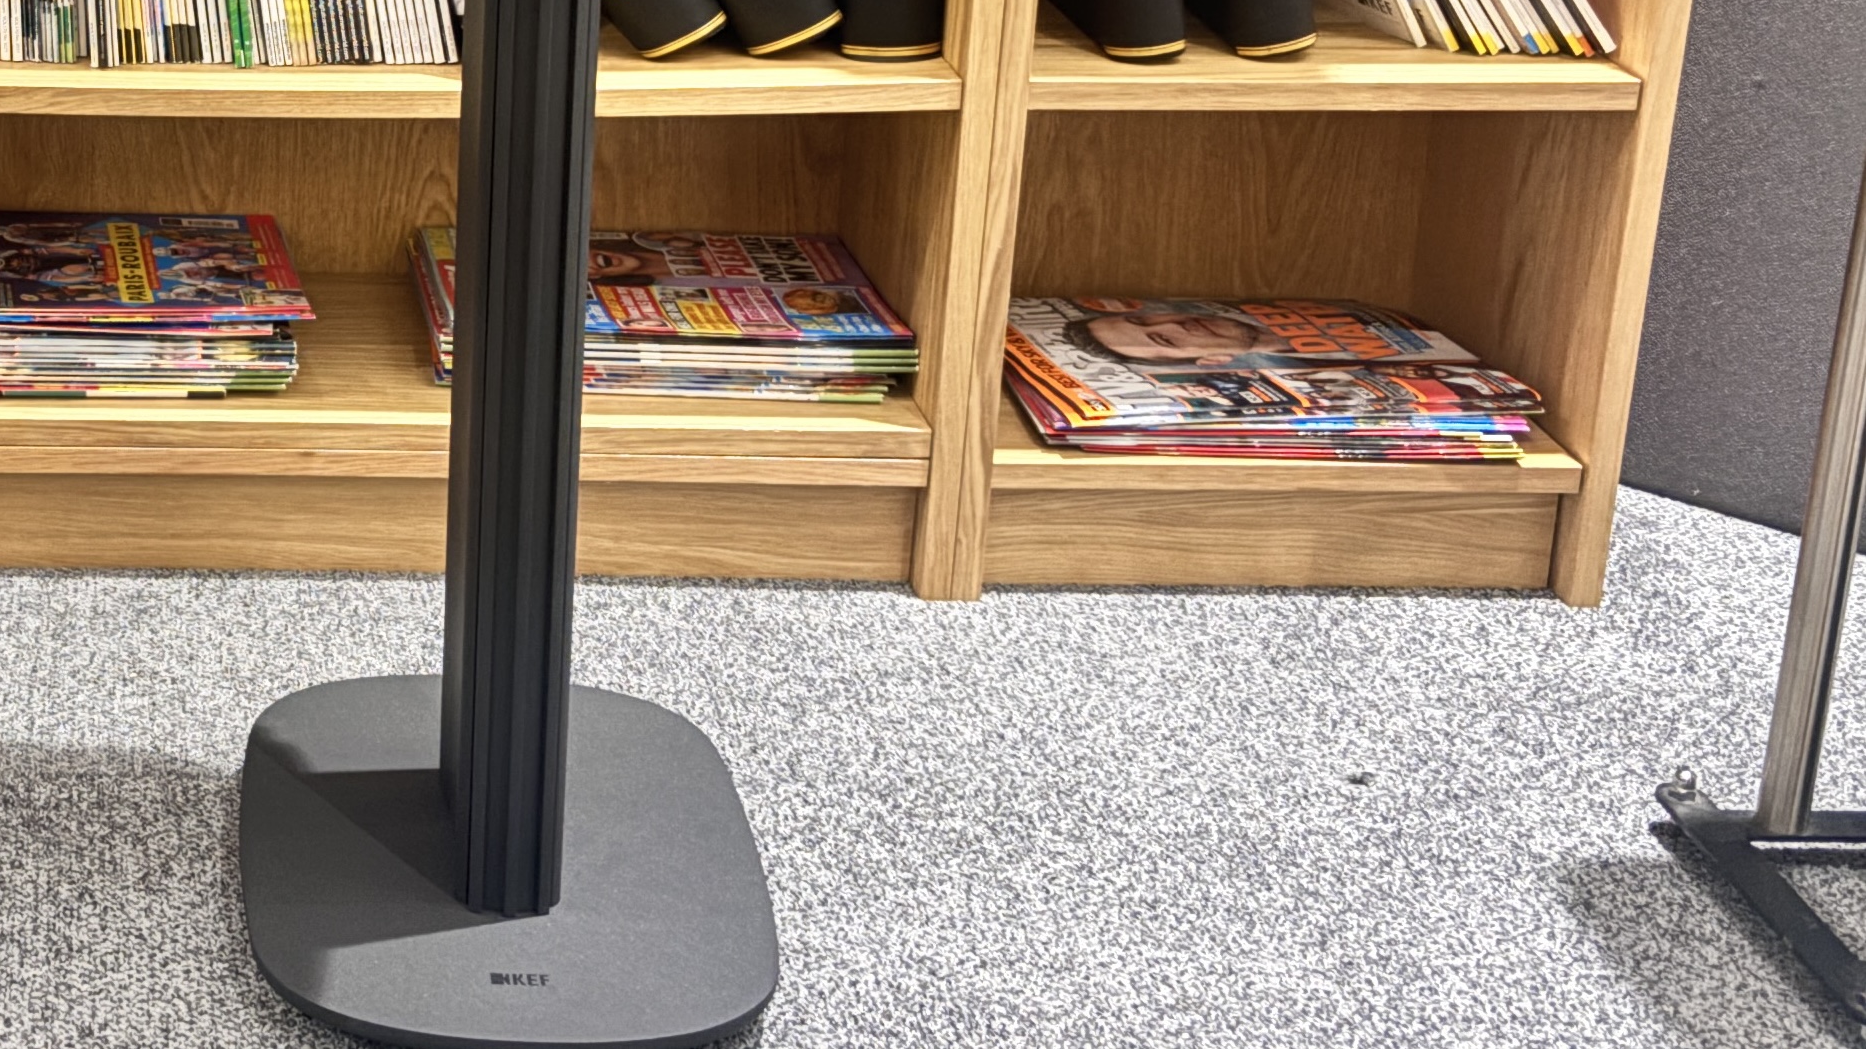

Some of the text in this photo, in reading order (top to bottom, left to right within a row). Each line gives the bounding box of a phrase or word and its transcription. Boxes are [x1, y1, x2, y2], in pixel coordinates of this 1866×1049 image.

[119, 224, 148, 302] PARIS-ROUBAIX
[707, 236, 756, 277] PLEASE
[1241, 304, 1343, 353] DEEP
[512, 973, 550, 986] KEF
